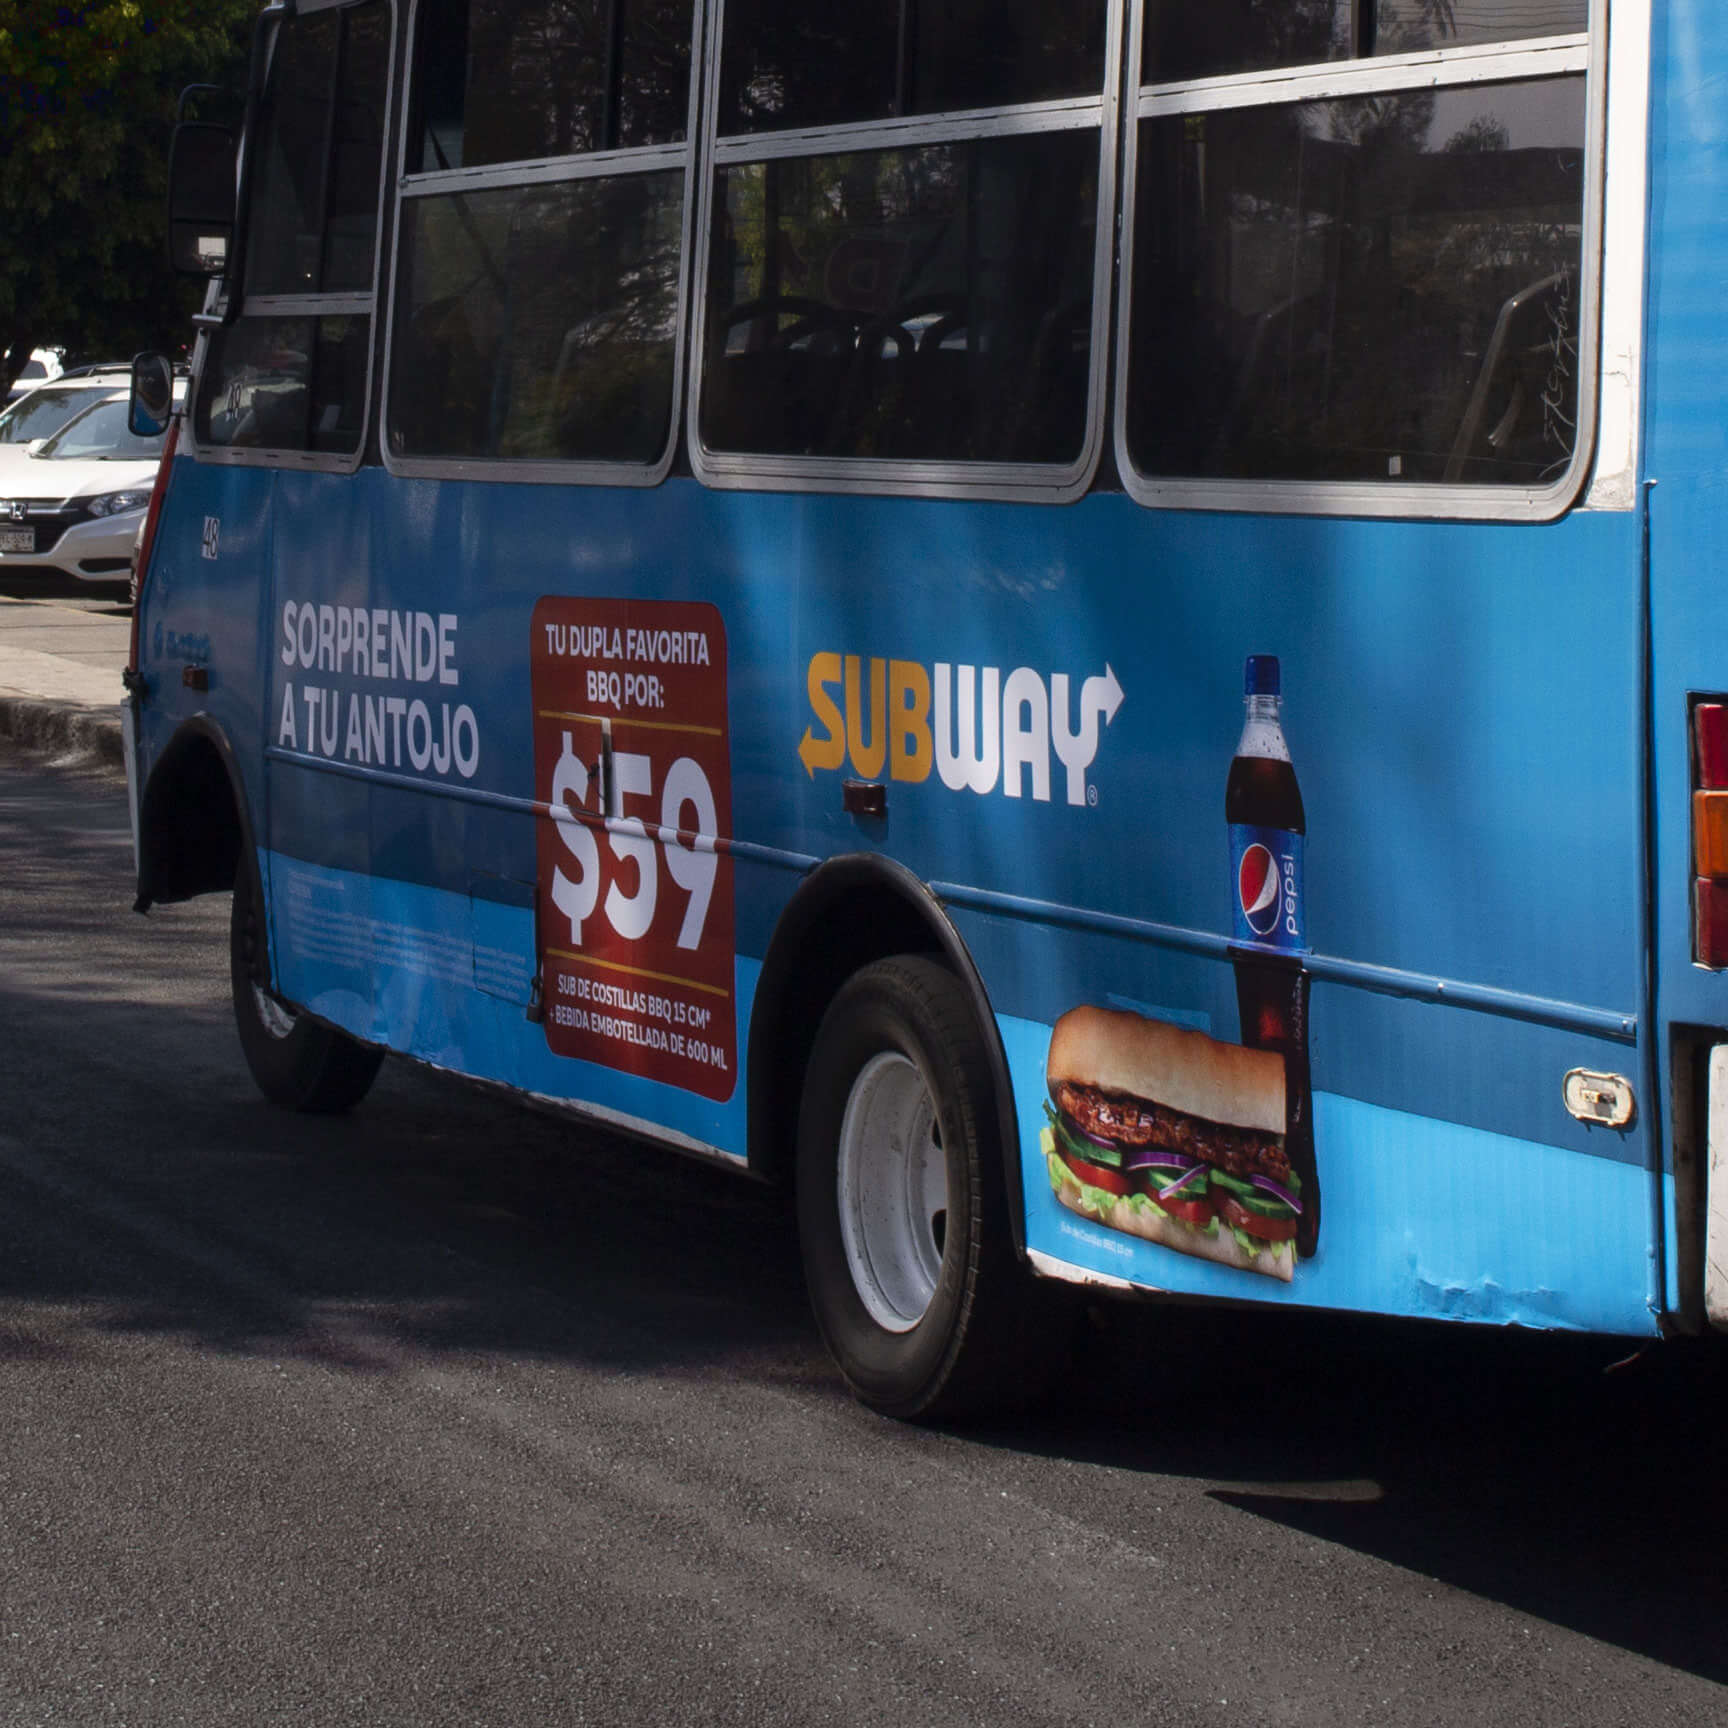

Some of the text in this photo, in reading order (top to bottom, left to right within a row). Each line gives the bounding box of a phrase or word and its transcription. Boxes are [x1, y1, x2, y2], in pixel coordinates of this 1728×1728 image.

[203, 519, 218, 558] 48
[281, 599, 458, 686] SORPRENDE
[545, 624, 711, 666] TU DUPLA FAVORITA
[586, 670, 665, 711] BBQ POR:
[280, 683, 480, 778] A TU ANTOJO
[798, 651, 1125, 806] SUBWAY
[548, 731, 719, 953] $59
[1281, 854, 1299, 936] pepsi
[557, 973, 577, 995] SUB
[578, 978, 591, 999] DE
[592, 982, 647, 1014] COSTILLAS
[648, 995, 672, 1024] BBQ
[673, 1001, 687, 1024] 15
[555, 1004, 591, 1031] BEBIDA
[590, 1012, 669, 1052] EMBOTELLADA
[670, 1032, 685, 1057] DE
[687, 1039, 709, 1064] 600
[710, 1045, 729, 1071] ML
